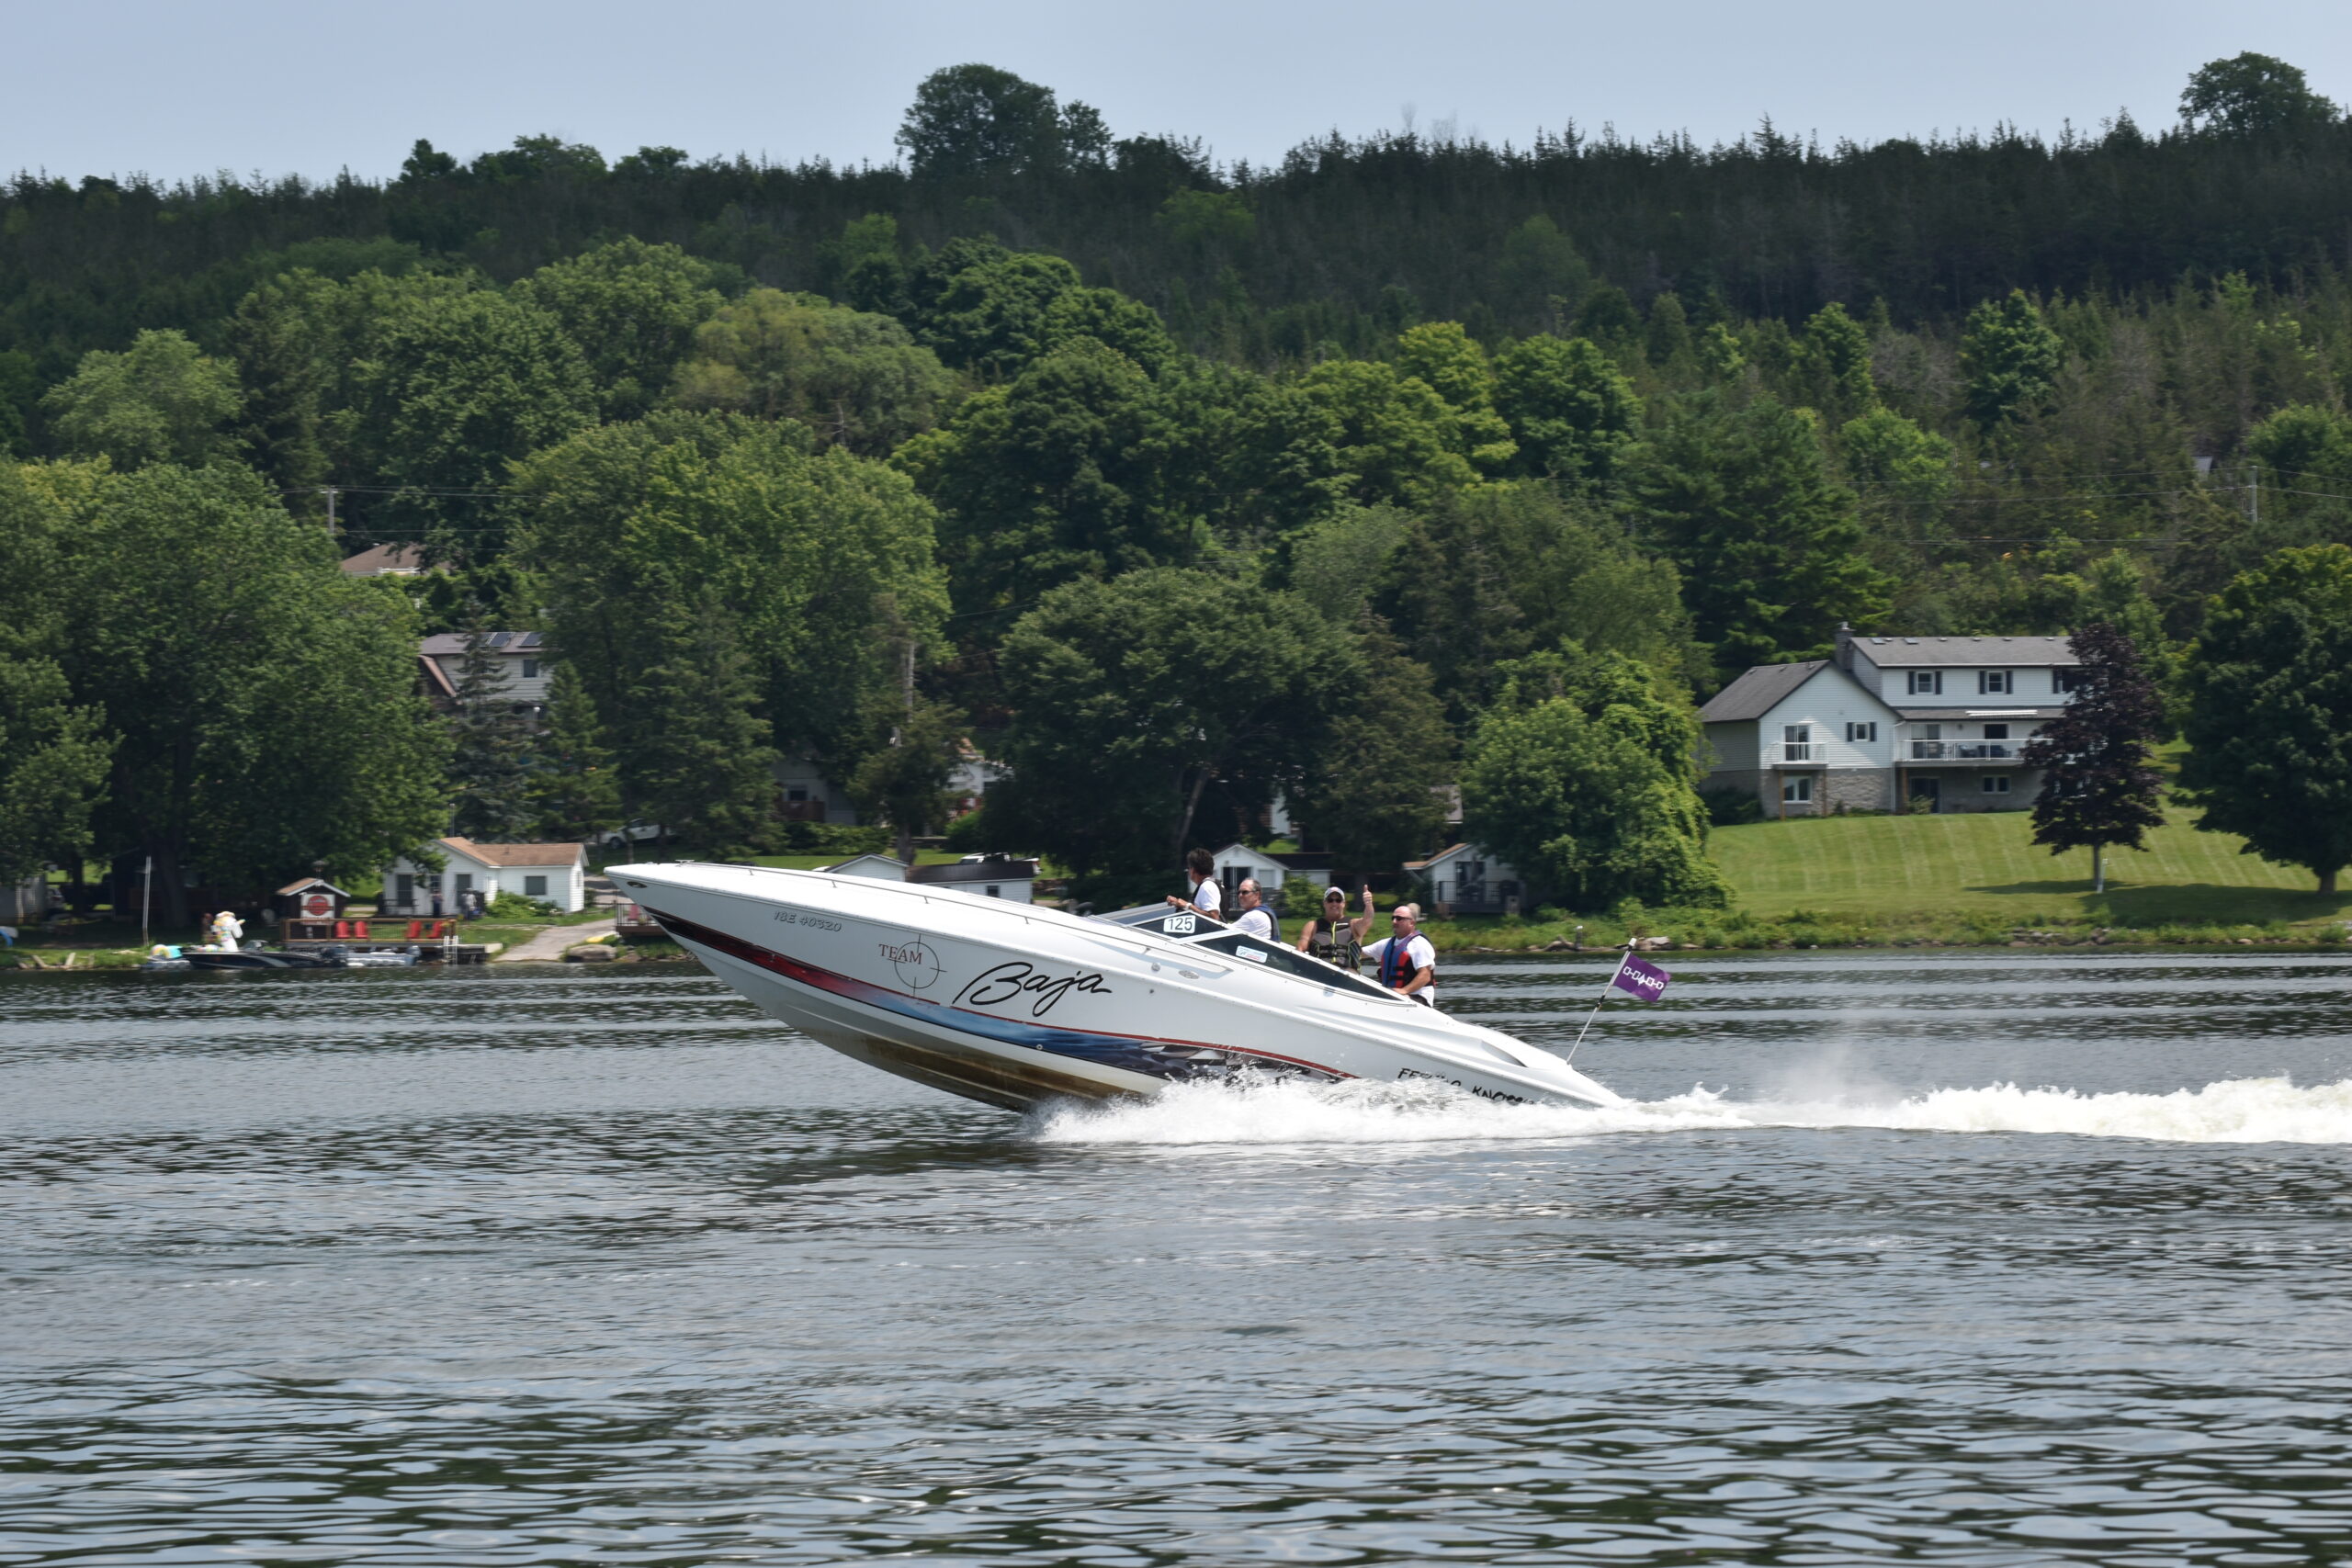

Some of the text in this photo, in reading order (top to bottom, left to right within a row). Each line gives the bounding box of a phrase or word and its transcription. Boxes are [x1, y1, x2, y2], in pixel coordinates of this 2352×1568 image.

[1168, 917, 1193, 931] 125
[878, 943, 922, 964] TEAM
[952, 962, 1113, 1017] Baja
